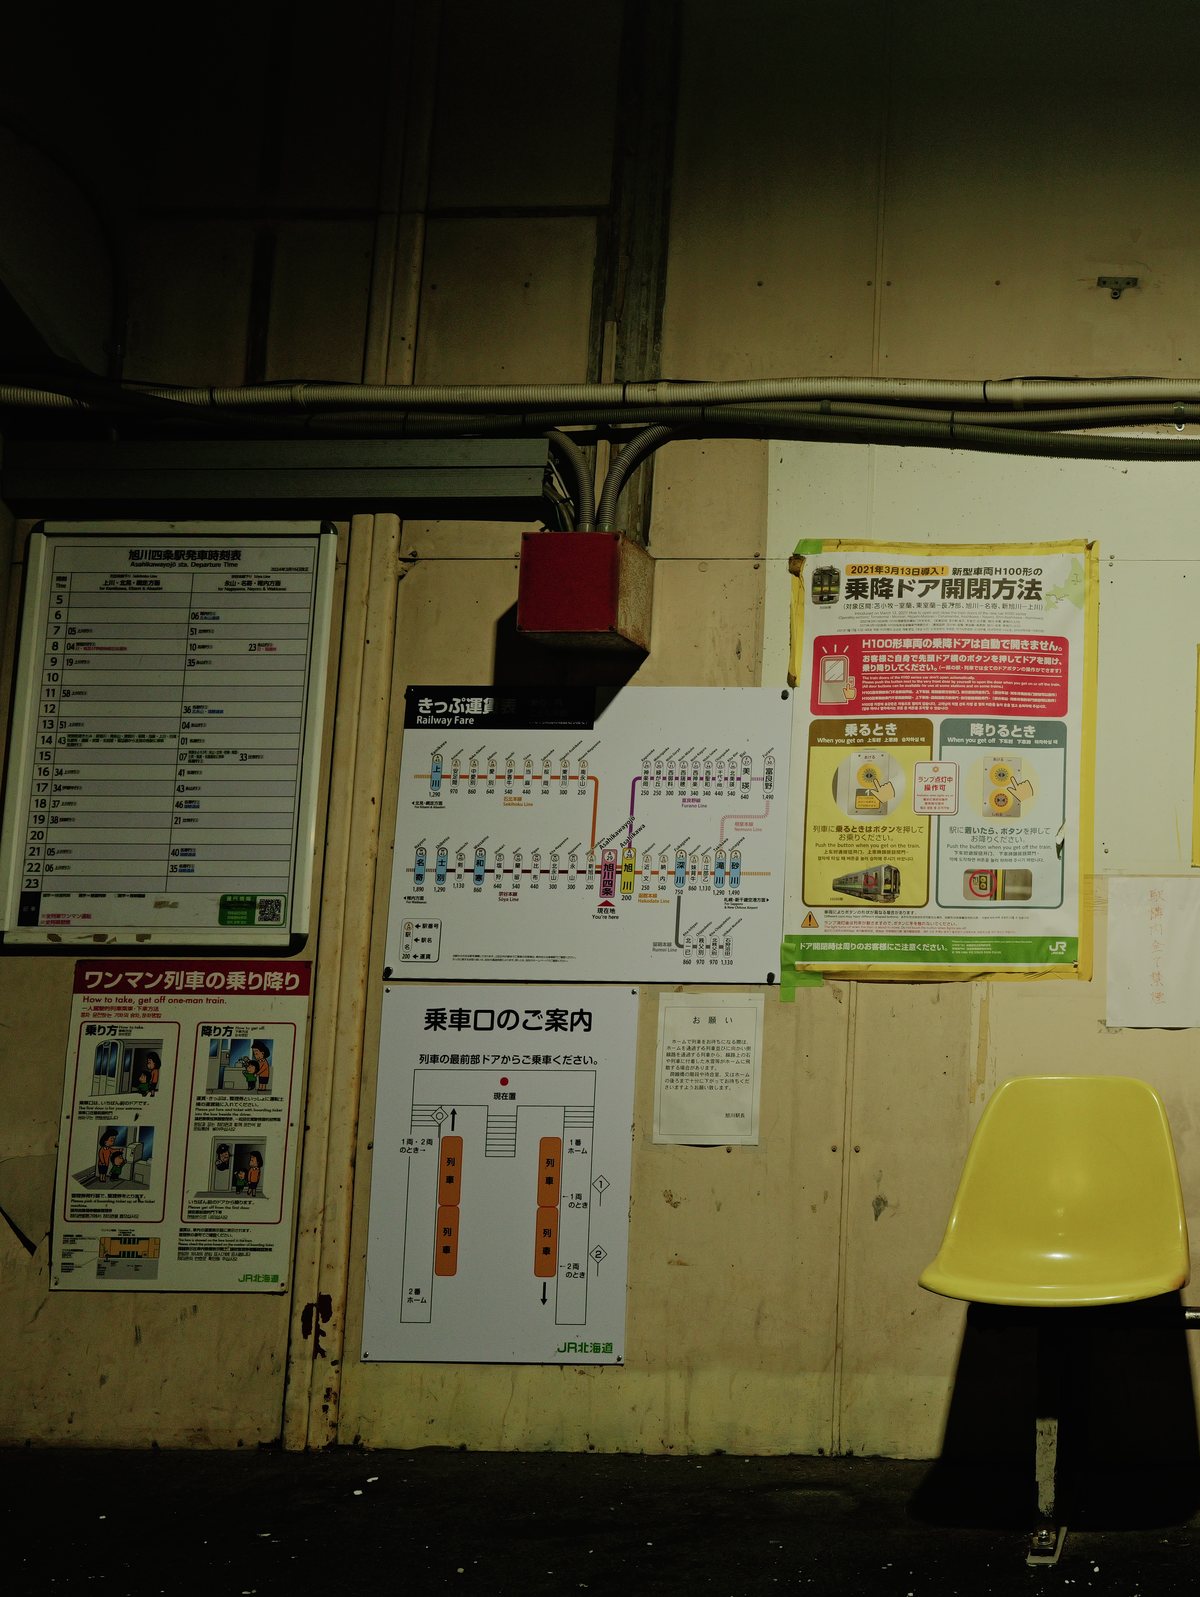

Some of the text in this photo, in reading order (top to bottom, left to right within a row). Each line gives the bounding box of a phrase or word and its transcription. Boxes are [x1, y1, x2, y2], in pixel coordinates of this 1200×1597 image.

[128, 550, 241, 561] 旭川四条駅発車時刻表
[952, 567, 1043, 576] 新型車両H100形の
[845, 577, 1042, 600] 乗降ドア開閉方法
[56, 596, 63, 604] 5
[53, 626, 60, 635] 7
[52, 642, 58, 650] 8
[862, 638, 1062, 651] H100形車両の乗降ドアは自動で開きません。
[46, 689, 56, 697] 11
[44, 704, 56, 713] 12
[416, 716, 474, 726] Railway Fare
[845, 723, 898, 737] 乗るとき
[970, 723, 1036, 738] 降りるとき
[38, 768, 50, 776] 16
[620, 824, 645, 848] Asahikawa
[27, 863, 41, 872] 22
[602, 864, 614, 896] 旭川四条
[622, 864, 632, 890] 旭川
[25, 879, 39, 888] 23
[800, 942, 948, 952] ドア開閉時は周りのお客様にご注意ください。
[1049, 942, 1066, 952] JR
[84, 971, 300, 991] ワンマン列車の乗り降り
[82, 996, 102, 1004] How
[115, 996, 135, 1005] take,
[138, 997, 152, 1006] get
[155, 996, 166, 1004] off
[206, 996, 227, 1004] train.
[424, 1008, 593, 1033] 乗車口のご案内
[85, 1025, 118, 1036] 乗り方
[201, 1025, 233, 1037] 降り方
[419, 1054, 597, 1065] 列車の最前部ドアからご乗車ください。
[445, 1157, 456, 1184] 列車
[546, 1158, 555, 1185] 列車
[443, 1227, 452, 1254] 列車
[542, 1228, 552, 1255] 列車
[595, 1250, 602, 1258] 2
[238, 1274, 279, 1283] JR北海道
[557, 1342, 613, 1354] JR北海道
